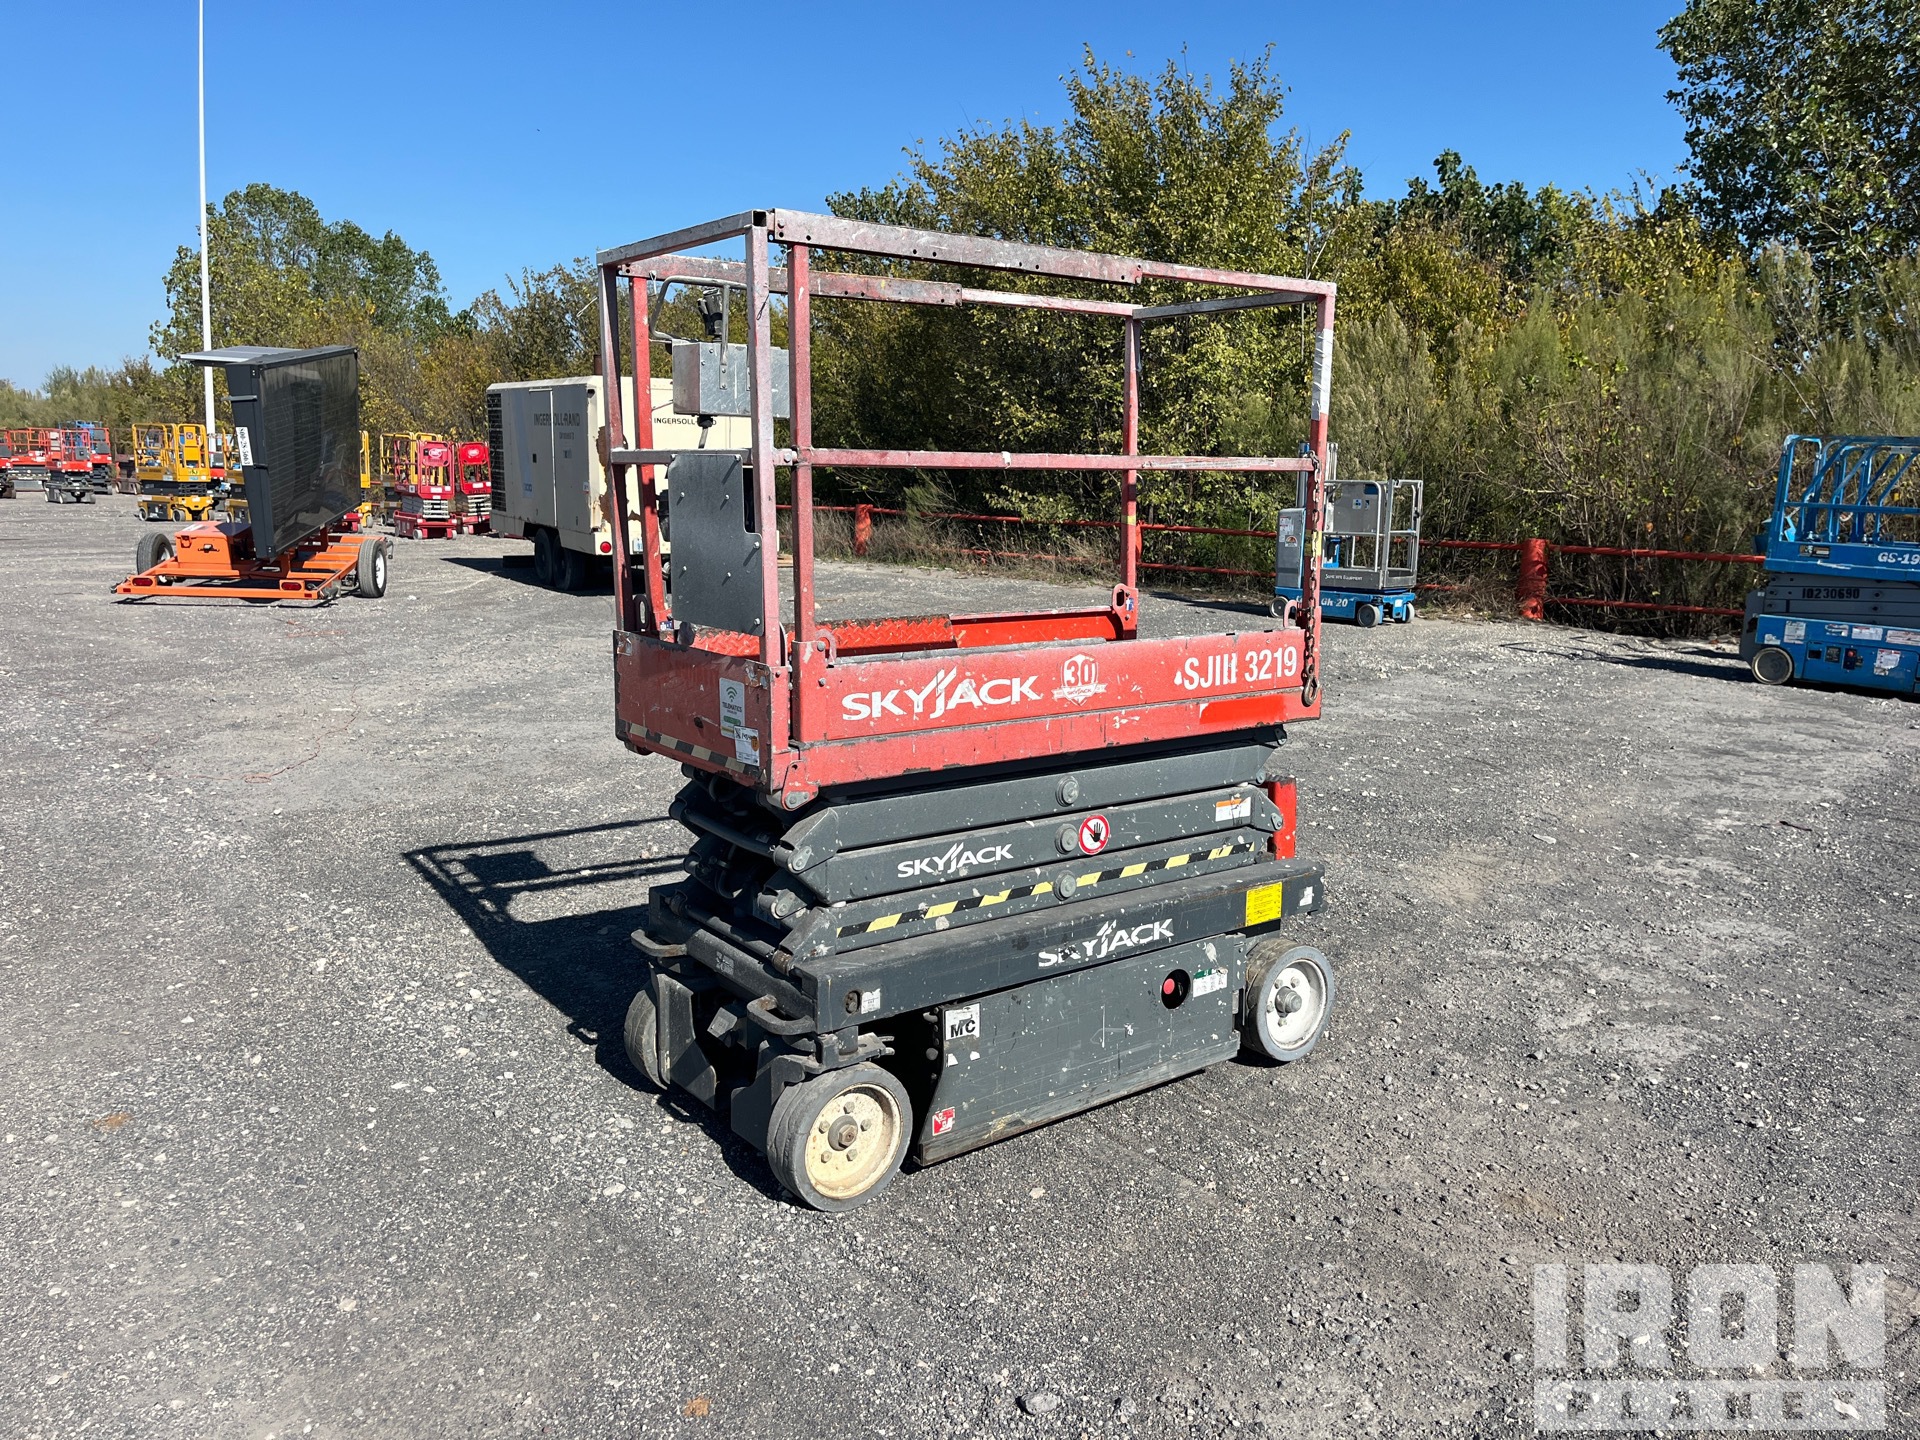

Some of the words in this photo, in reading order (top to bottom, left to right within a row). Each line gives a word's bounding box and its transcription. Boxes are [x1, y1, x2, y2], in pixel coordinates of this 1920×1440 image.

[1877, 551, 1920, 565] GS-19
[1802, 588, 1860, 599] 10230690
[1066, 658, 1093, 687] 30
[1244, 646, 1298, 683] 3219
[841, 666, 1042, 721] SKYJACK
[897, 842, 1014, 878] SKYJACK
[1038, 918, 1174, 967] SKYJACK
